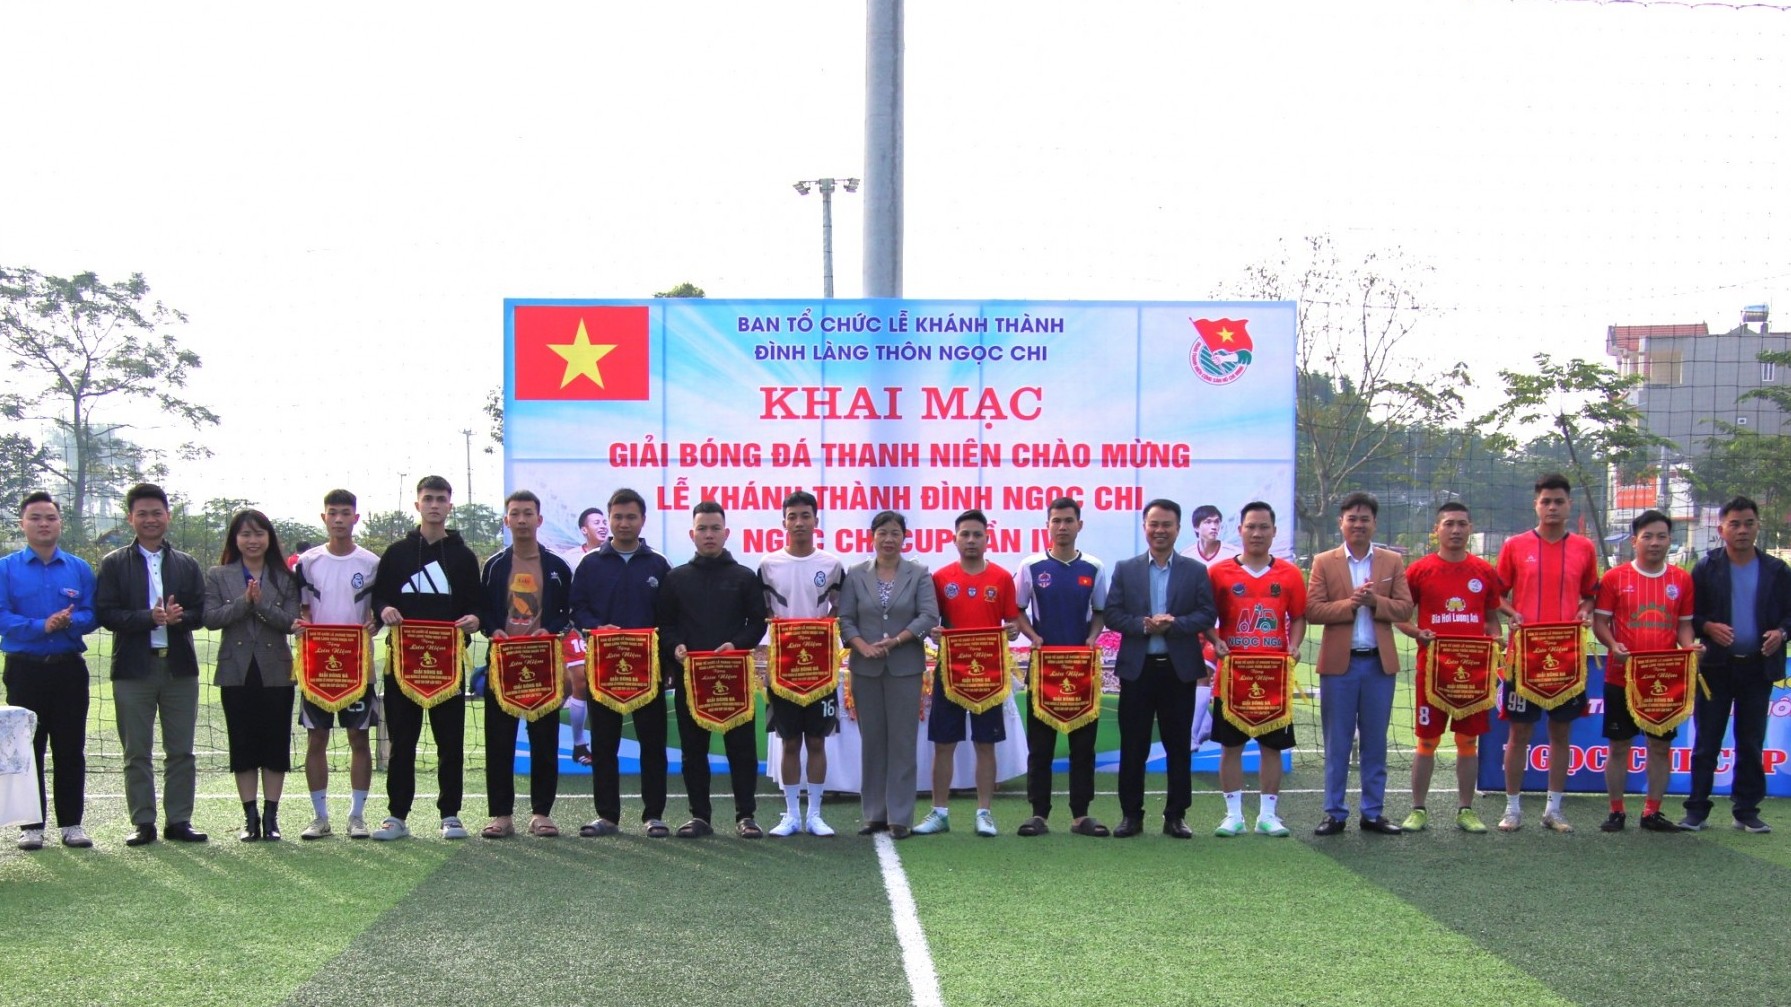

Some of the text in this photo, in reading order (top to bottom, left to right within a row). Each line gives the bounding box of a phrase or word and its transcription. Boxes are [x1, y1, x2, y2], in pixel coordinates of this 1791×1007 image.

[738, 308, 1064, 332] BAN TỔ CHỨC LỄ KHÁNH THÀNH
[755, 341, 1047, 365] ĐÌNH LÀNG THÔN NGỌC CHI
[760, 387, 1042, 428] KHAI MẠC
[609, 435, 1190, 468] GIẢI BÓNG ĐÁ THANH NIÊN CHÀO MỪNG
[657, 477, 689, 510] LỄ
[701, 481, 802, 510] KHÁN
[813, 481, 910, 510] THÀNH
[921, 481, 992, 510] ĐÌNH
[1095, 486, 1143, 511] CHI
[743, 529, 824, 553] NGC
[835, 529, 874, 553] CH
[985, 520, 1020, 552] ẦN
[1229, 637, 1260, 649] NGỌC
[821, 698, 835, 717] 16
[1507, 691, 1526, 712] 99
[1419, 706, 1430, 725] 8
[1502, 744, 1610, 776] GỌC
